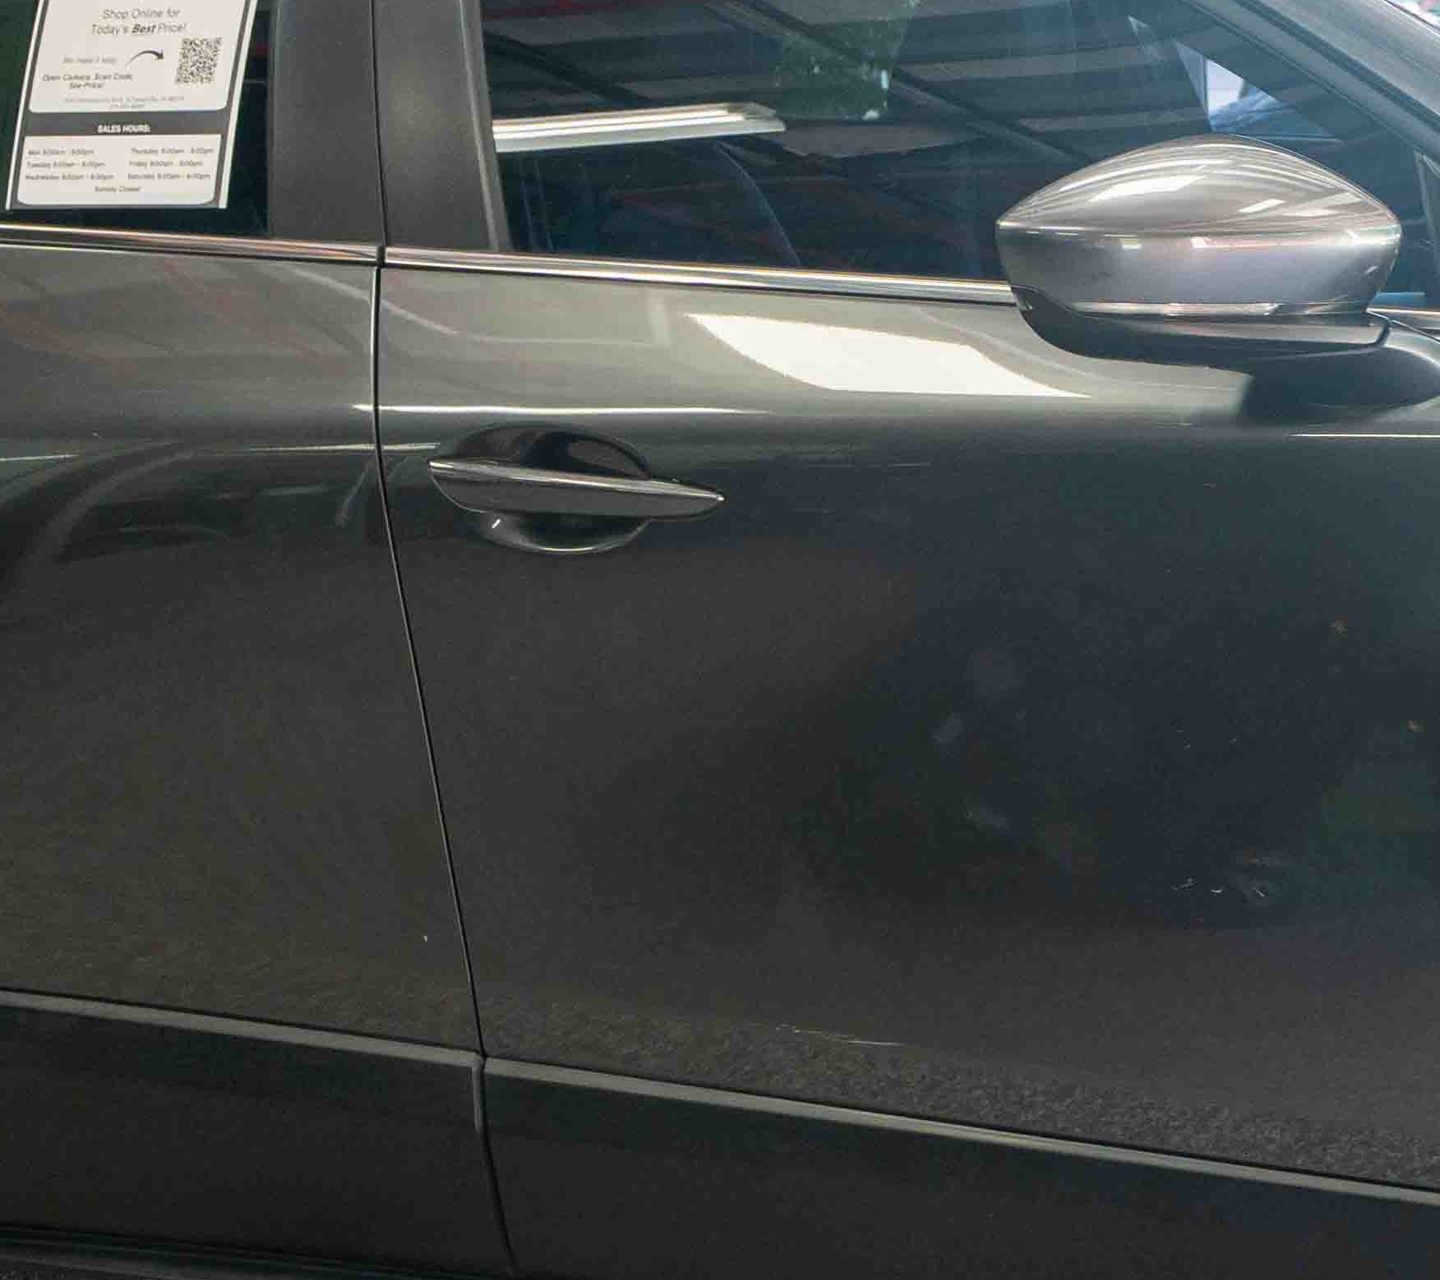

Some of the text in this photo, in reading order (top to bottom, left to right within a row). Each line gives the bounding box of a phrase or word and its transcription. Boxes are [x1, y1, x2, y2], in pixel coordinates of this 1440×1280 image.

[103, 7, 180, 20] Shop Online for
[91, 22, 187, 35] Today's Best Price!
[97, 124, 122, 133] SALES
